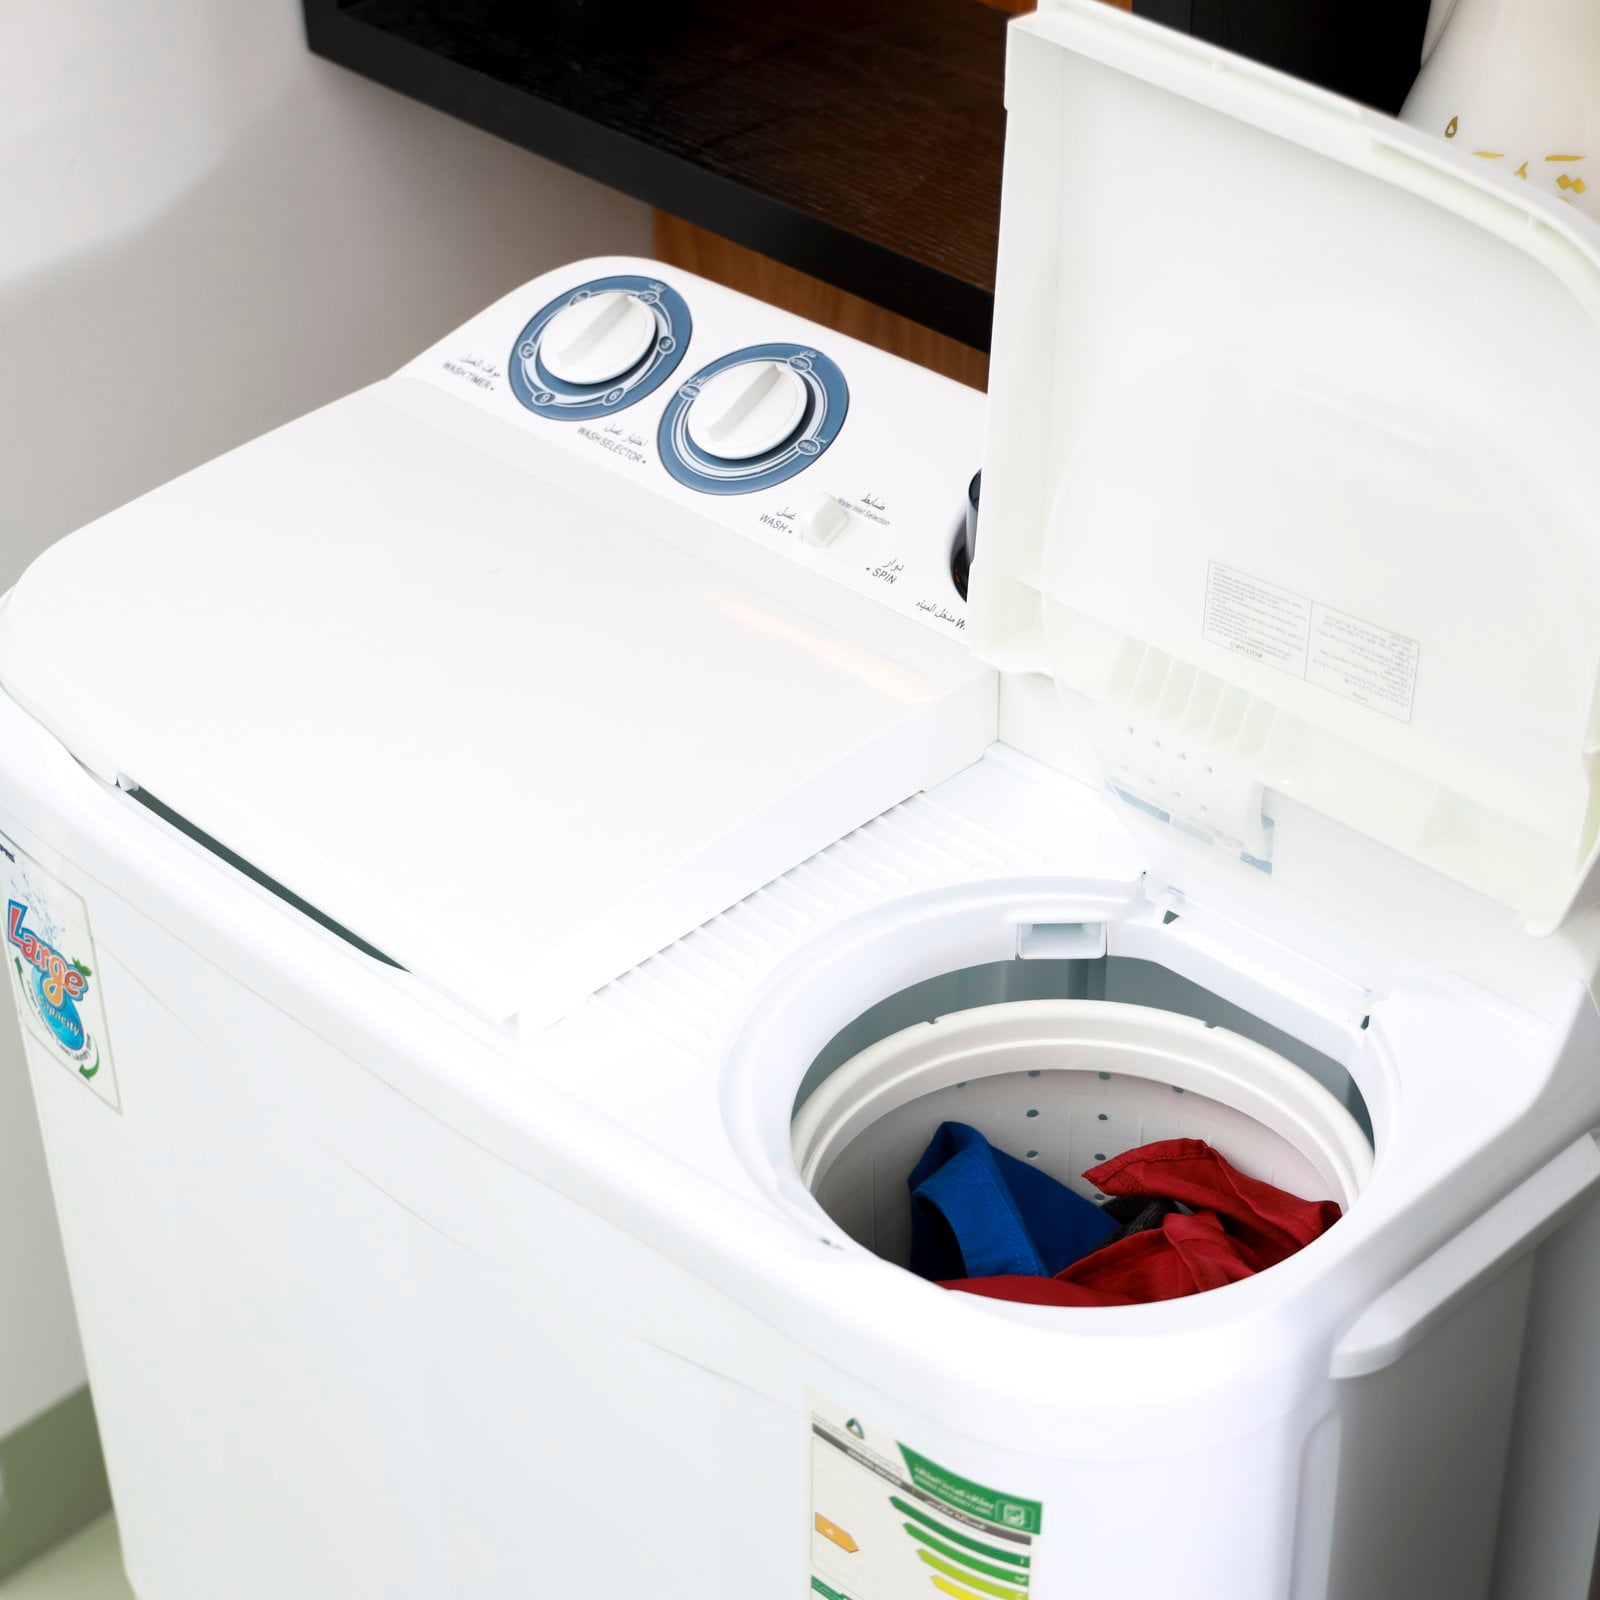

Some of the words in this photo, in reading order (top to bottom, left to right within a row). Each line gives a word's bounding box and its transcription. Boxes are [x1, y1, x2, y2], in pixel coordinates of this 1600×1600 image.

[663, 338, 671, 349] 3
[442, 362, 466, 377] WASH
[466, 372, 492, 389] TIMER
[577, 426, 600, 442] WASH
[599, 437, 643, 462] SELECTOR
[776, 506, 798, 520] غسل
[864, 511, 891, 527] Selection
[759, 513, 788, 532] WASH
[871, 567, 898, 584] SPIN
[8, 899, 88, 1010] Large
